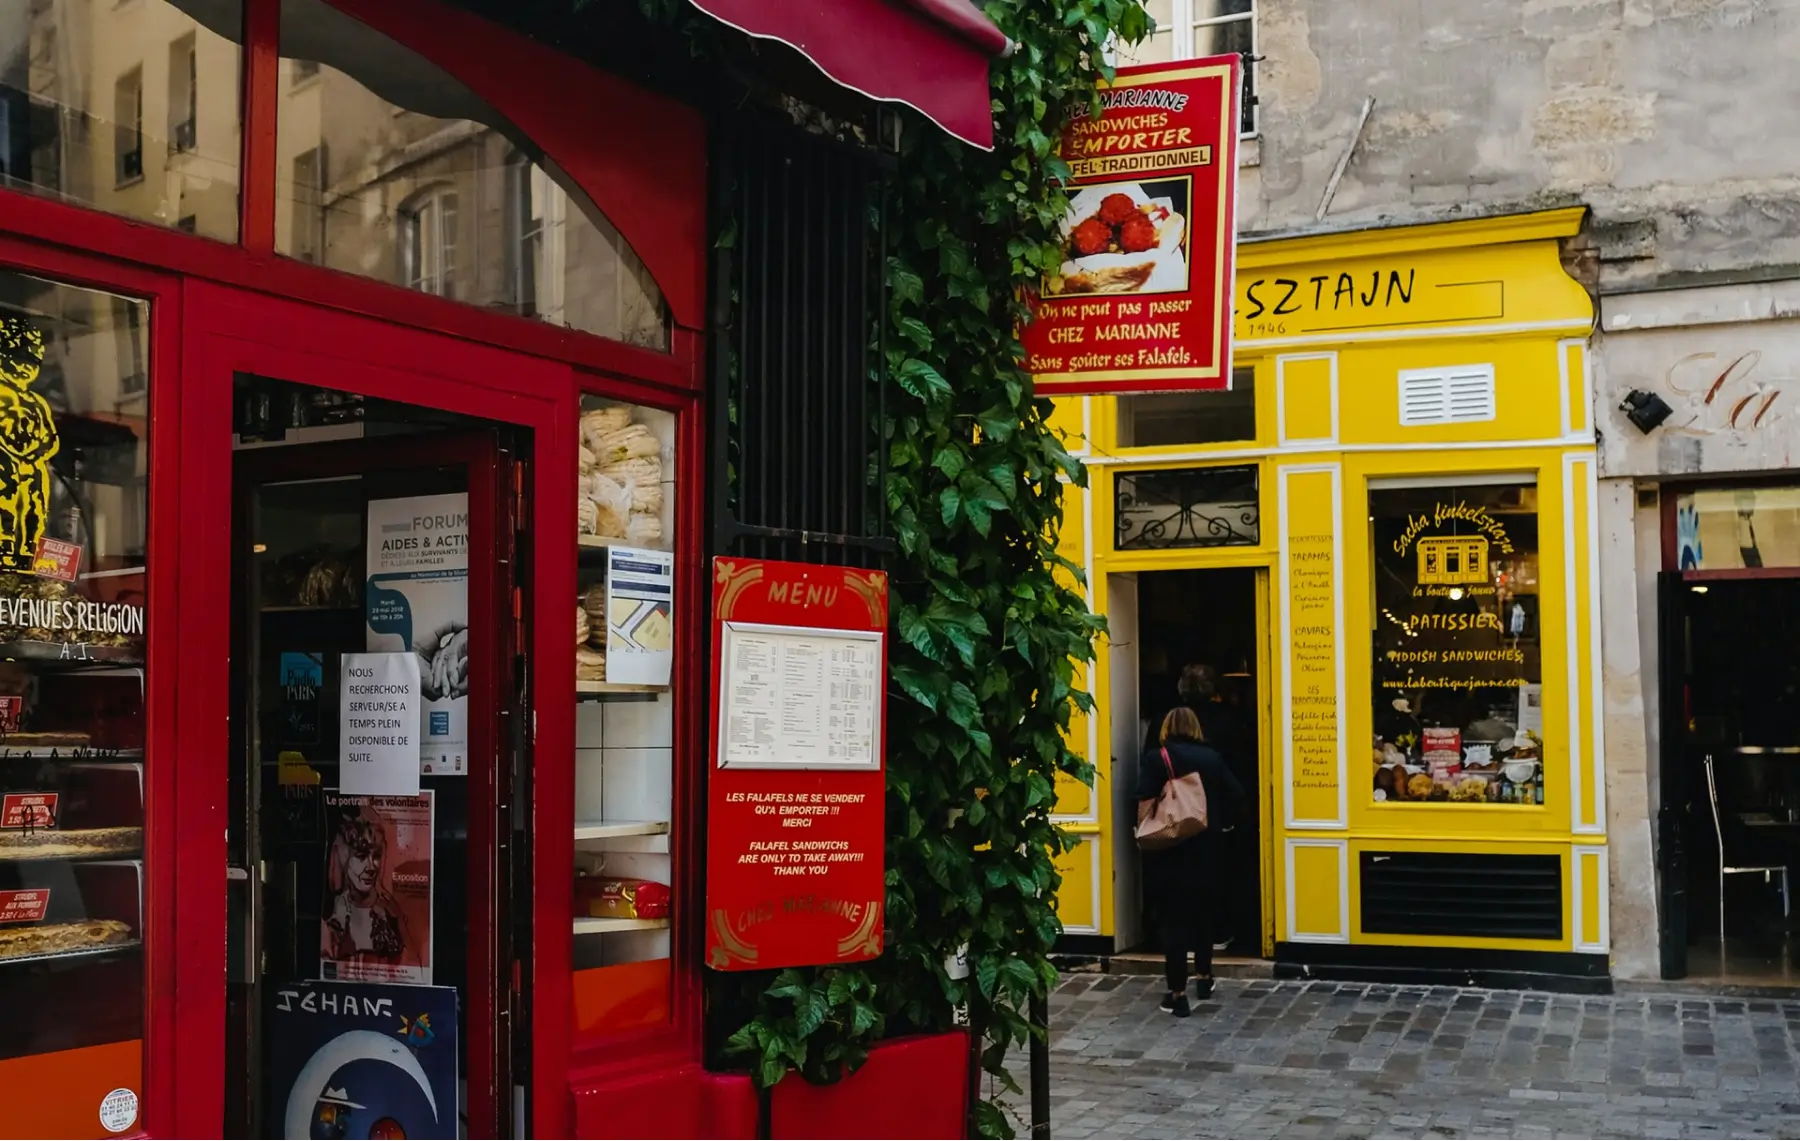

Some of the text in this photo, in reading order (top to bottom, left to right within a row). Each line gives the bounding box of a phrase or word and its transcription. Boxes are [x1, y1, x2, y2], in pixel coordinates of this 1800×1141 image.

[1100, 88, 1189, 113] MARIANNE
[1072, 112, 1168, 136] SANDWICHES
[1072, 150, 1207, 176] FEL TRADITIONNEL
[1235, 268, 1415, 319] SZTAJN
[1039, 299, 1192, 321] On ne peut pas passer
[1048, 322, 1181, 344] CHEZ MARIANNE
[1249, 321, 1286, 336] 1946
[1030, 353, 1062, 370] Sans
[1068, 351, 1112, 372] goûter
[1114, 352, 1134, 366] ses
[413, 514, 468, 531] FORUM
[381, 538, 418, 551] AIDES
[423, 537, 431, 548] &
[421, 549, 458, 557] SURVIVANTS
[768, 580, 838, 608] MENU
[1410, 613, 1500, 630] PATISSIER
[1295, 626, 1331, 636] CAVIARS
[1442, 650, 1521, 663] SANDWICHES
[349, 668, 373, 678] NOUS
[286, 685, 316, 701] PARIS
[349, 685, 409, 695] RECHERCHONS
[349, 702, 406, 713] SERVEUR/SE A
[349, 719, 401, 729] TEMPS PLEIN
[349, 736, 408, 746] DISPONIBLE DE
[349, 753, 374, 762] SUITE.
[326, 795, 337, 806] Le
[726, 793, 865, 803] LES FALAFELS NE SE VENDENT
[755, 805, 840, 815] QU'A EMPORTER !!!
[782, 818, 812, 827] MERCI
[749, 841, 849, 850] FALAFEL SANDWICHS
[738, 853, 864, 863] ARE ONLY TO TAKE AWAY!!!
[773, 866, 828, 875] THANK YOU
[392, 871, 428, 882] Exposition
[105, 1095, 134, 1105] VITRIER
